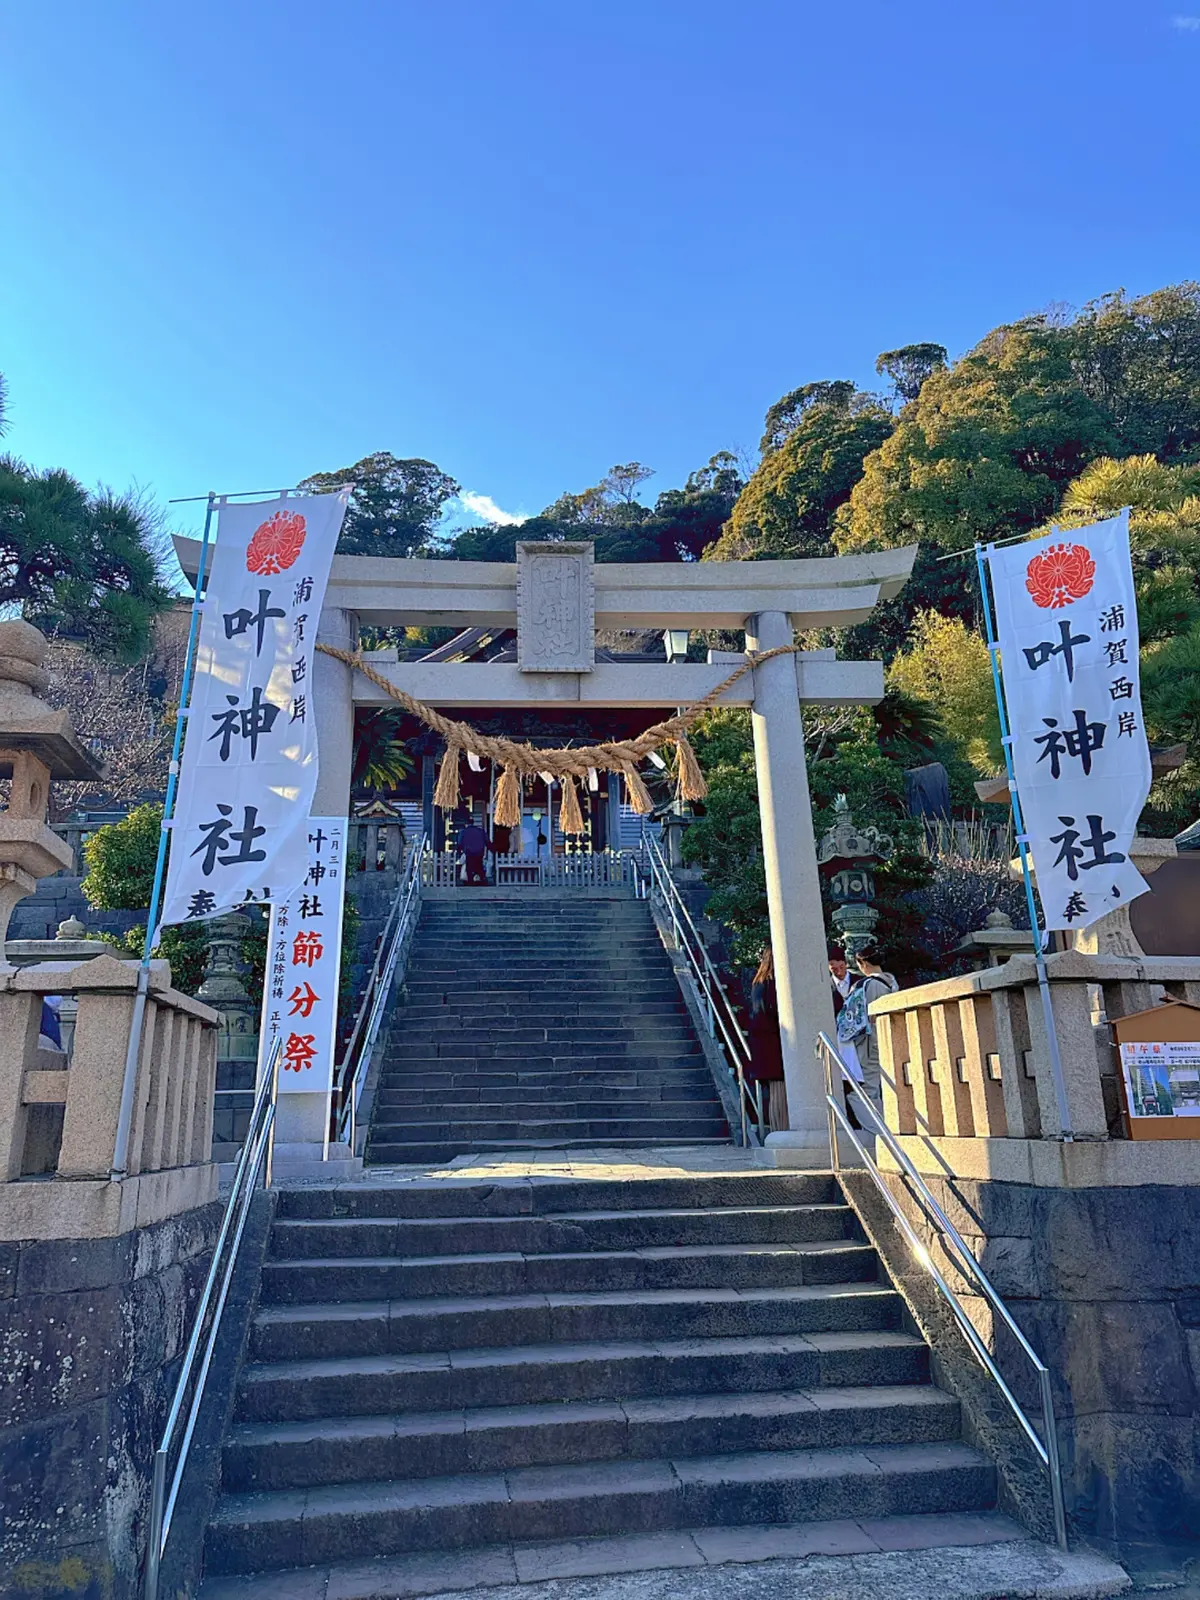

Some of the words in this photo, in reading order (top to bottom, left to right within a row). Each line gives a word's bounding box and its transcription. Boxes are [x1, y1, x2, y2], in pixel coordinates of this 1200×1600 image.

[189, 589, 286, 877] 叶神社
[1098, 604, 1138, 739] 浦賀西岸
[1022, 620, 1125, 881] 叶神社
[329, 828, 341, 878] 二月三日
[271, 899, 290, 999] 方除・方位除祈祷
